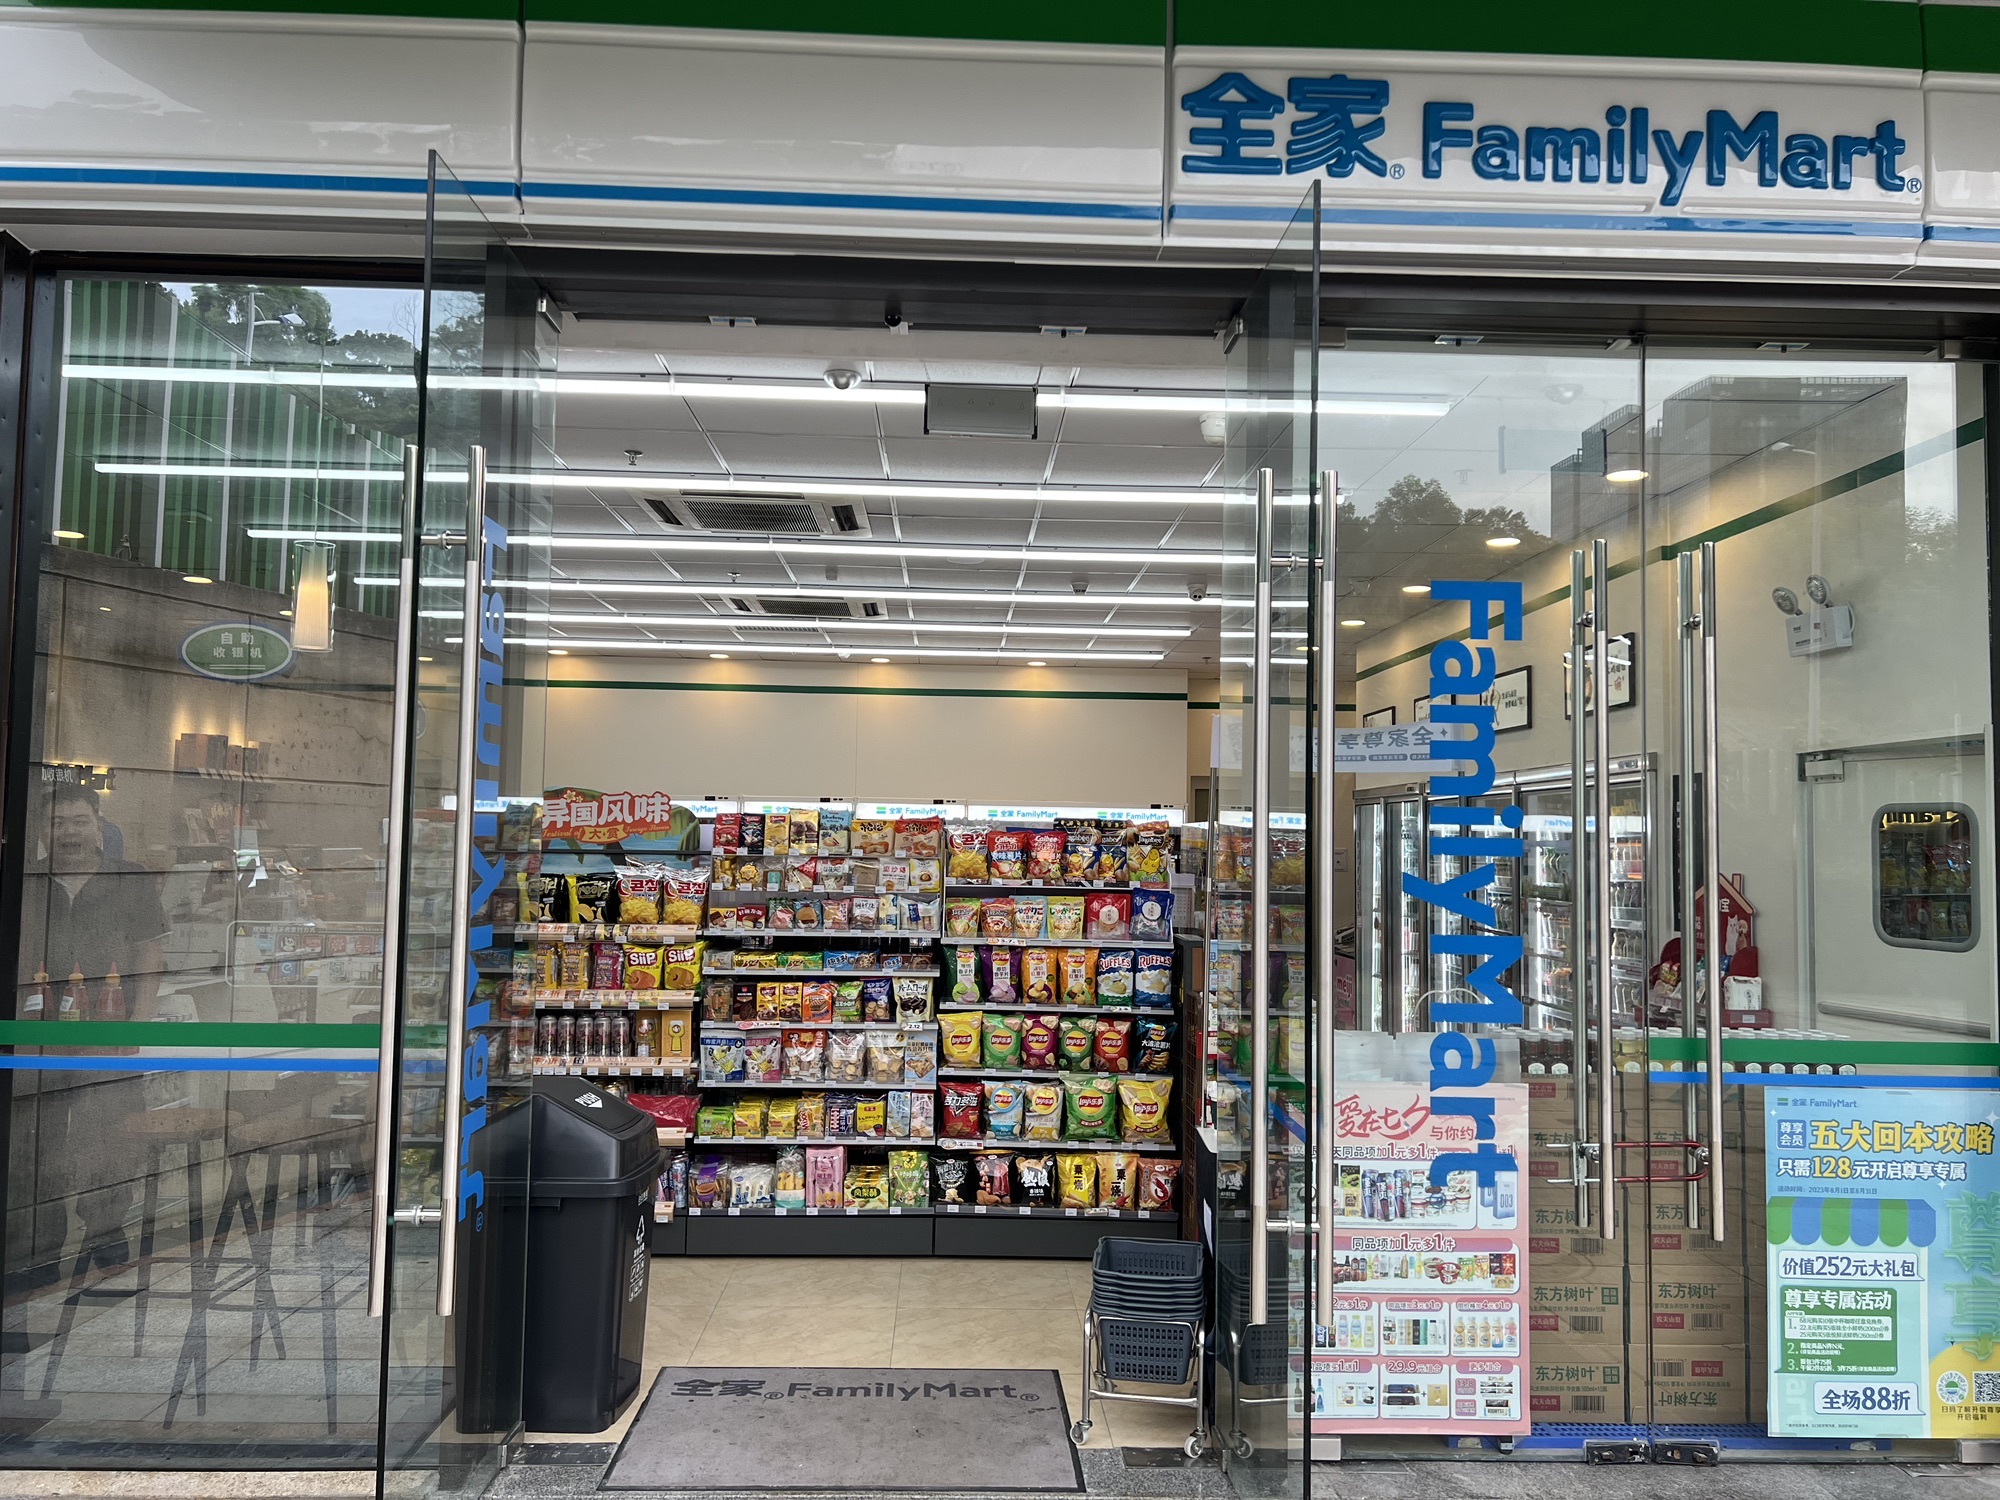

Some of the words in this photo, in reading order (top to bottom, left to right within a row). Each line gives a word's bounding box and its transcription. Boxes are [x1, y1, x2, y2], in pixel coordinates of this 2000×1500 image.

[1181, 72, 1389, 178] 全家
[1422, 101, 1906, 206] FamilyMart
[220, 632, 254, 645] 自助
[213, 646, 262, 659] 收银机
[543, 792, 671, 829] 异国风味
[889, 807, 902, 815] 全家
[905, 806, 948, 816] FamilyMart
[1000, 810, 1015, 818] 全家
[1016, 810, 1058, 819] FamilyMart
[1125, 812, 1167, 821] FamilyMart
[1403, 580, 1523, 1188] FamilyMart
[630, 952, 656, 965] SiiP
[1099, 957, 1131, 971] RUFFLES
[1139, 955, 1172, 968] RUFFLES
[1810, 1099, 1858, 1109] FamilyMart
[1430, 1126, 1475, 1141] 与你约
[1780, 1134, 1803, 1147] 会员
[1809, 1120, 1995, 1154] 五大回本攻略
[1777, 1156, 1967, 1180] 只需128元开启尊享专属
[1351, 1233, 1456, 1251] 同品项加1元多1件
[1782, 1256, 1916, 1277] 价值252元大礼包
[1534, 1286, 1594, 1302] 东方树叶
[1658, 1283, 1717, 1299] 东方树叶
[1784, 1289, 1892, 1310] 尊享专属活动
[1387, 1360, 1442, 1374] 29.9元组合
[1535, 1366, 1595, 1381] 东方树叶
[671, 1378, 767, 1398] 全家
[788, 1382, 1018, 1401] FamilyMart
[1658, 1391, 1717, 1407] 东方树叶
[1822, 1387, 1911, 1412] 全场88折
